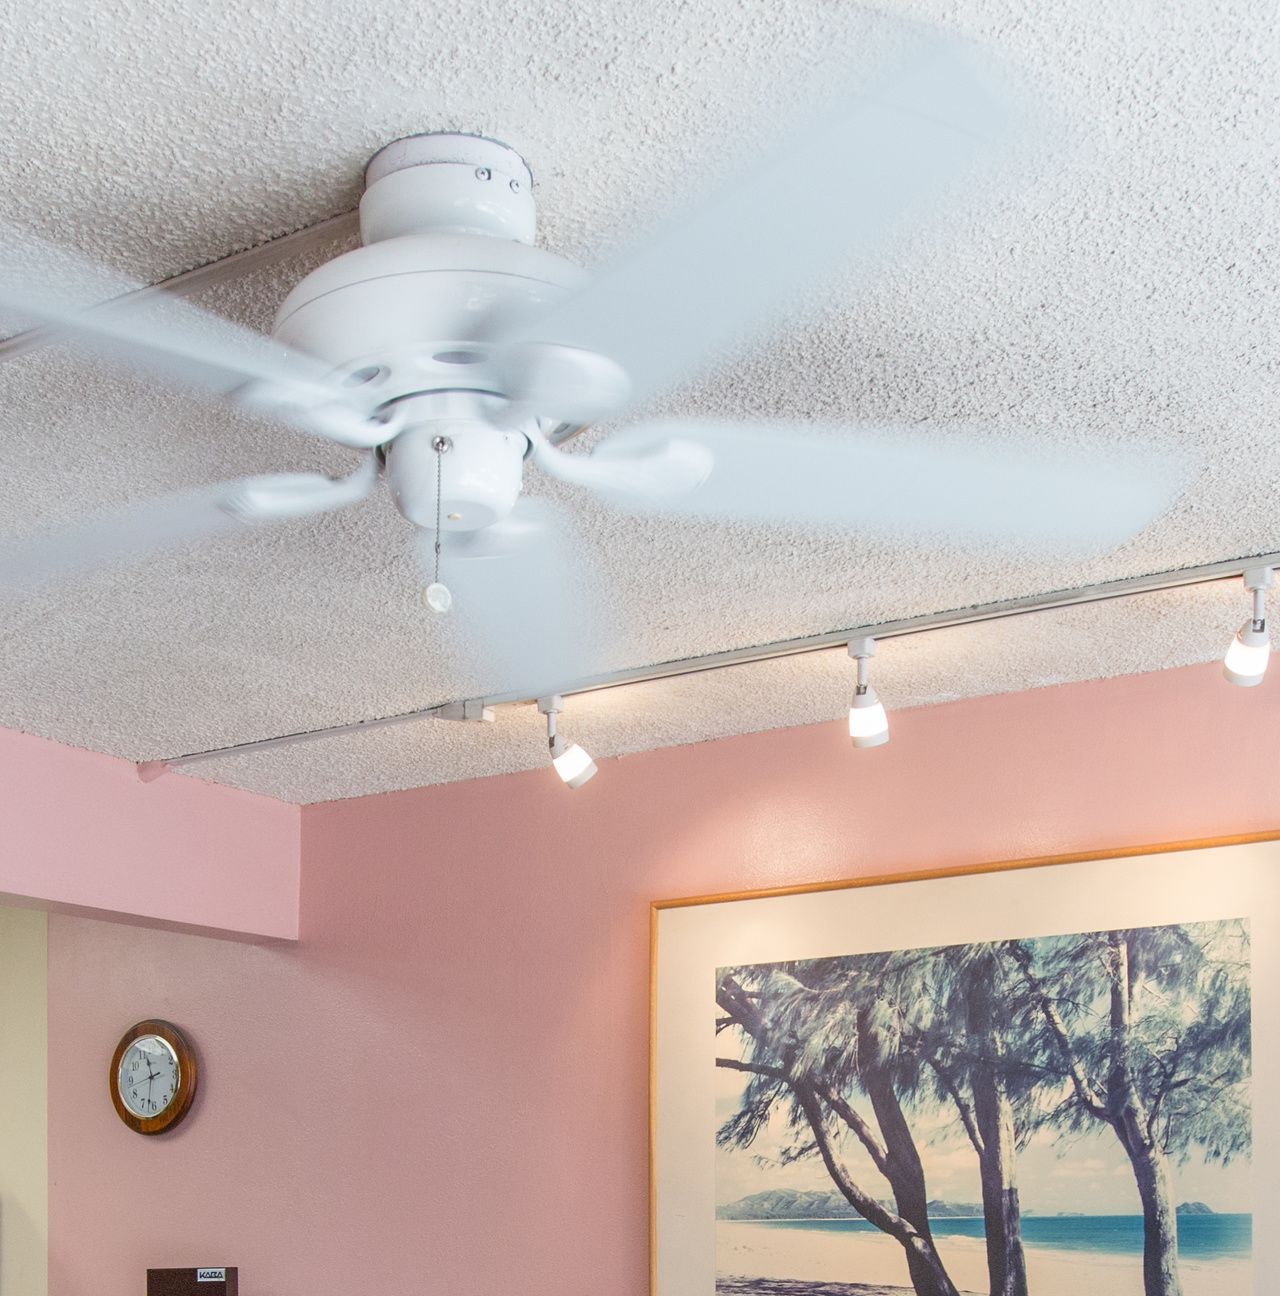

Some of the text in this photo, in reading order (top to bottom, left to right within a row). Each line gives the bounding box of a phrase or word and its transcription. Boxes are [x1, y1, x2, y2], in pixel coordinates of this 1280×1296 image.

[139, 1050, 146, 1060] 11
[168, 1056, 173, 1065] 2
[131, 1061, 139, 1071] 10
[128, 1076, 134, 1086] 9
[132, 1088, 138, 1099] 8
[140, 1098, 146, 1109] 7
[162, 1095, 168, 1105] 5
[151, 1101, 157, 1111] 6
[200, 1271, 223, 1279] KABA
